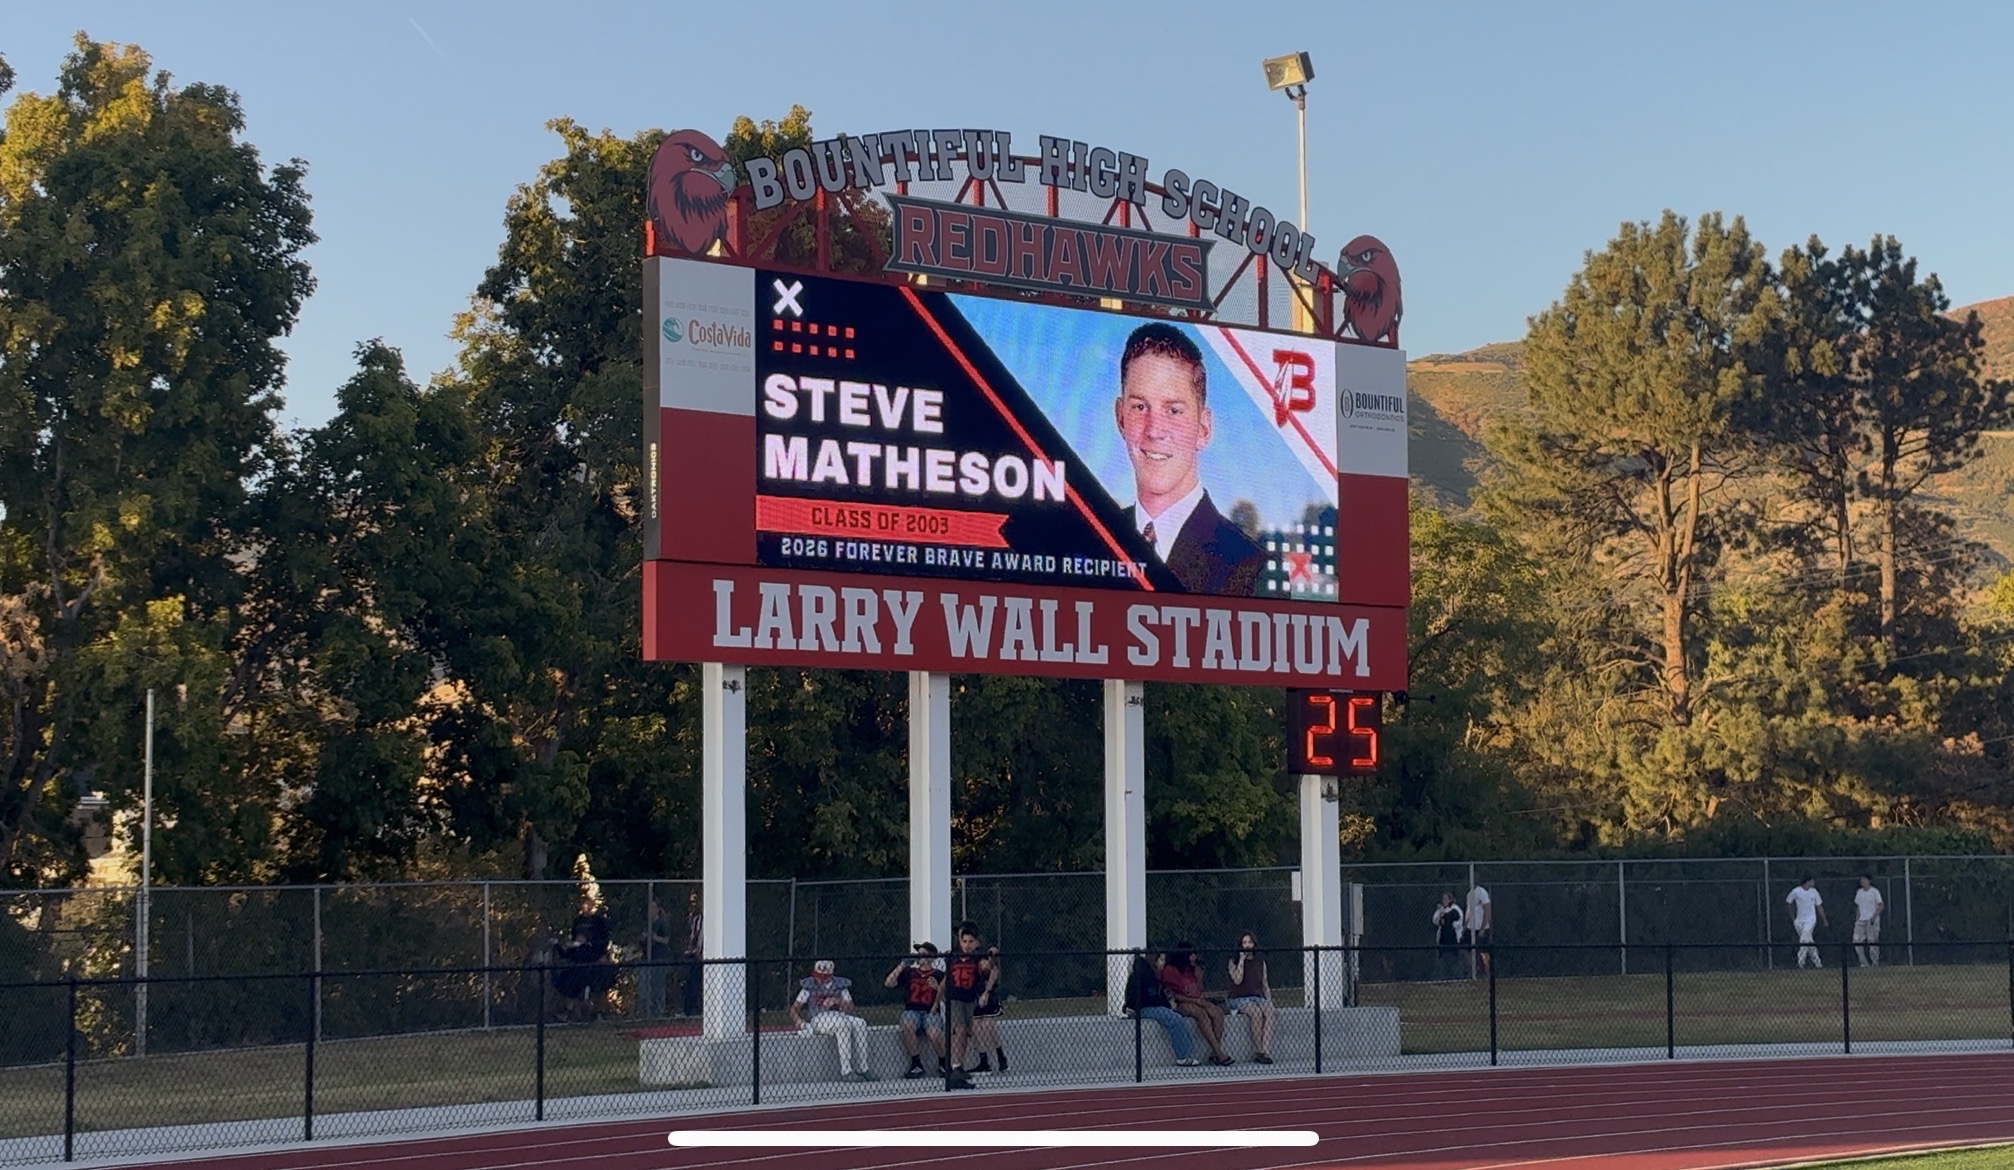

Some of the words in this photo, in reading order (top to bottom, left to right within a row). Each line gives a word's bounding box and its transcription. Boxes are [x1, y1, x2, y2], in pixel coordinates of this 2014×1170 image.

[745, 129, 1025, 210] BOUNTIFUL
[1039, 134, 1149, 206] HIGH
[1162, 169, 1320, 285] SCHOOL
[897, 203, 1202, 302] REDHAWKS
[764, 373, 944, 434] STEVE
[1355, 392, 1404, 413] BOUNTIFUL
[764, 433, 1066, 501] MATHESON
[811, 507, 871, 529] CLASS
[877, 512, 900, 530] OF
[906, 514, 949, 534] 2003
[781, 537, 828, 557] 2026
[835, 541, 917, 563] FOREVER
[925, 547, 985, 569] BRAVE
[992, 551, 1056, 573] AWARD
[713, 579, 924, 655] LARRY
[940, 593, 1109, 665] WALL
[1127, 604, 1371, 678] STADIUM
[1306, 695, 1378, 768] 25
